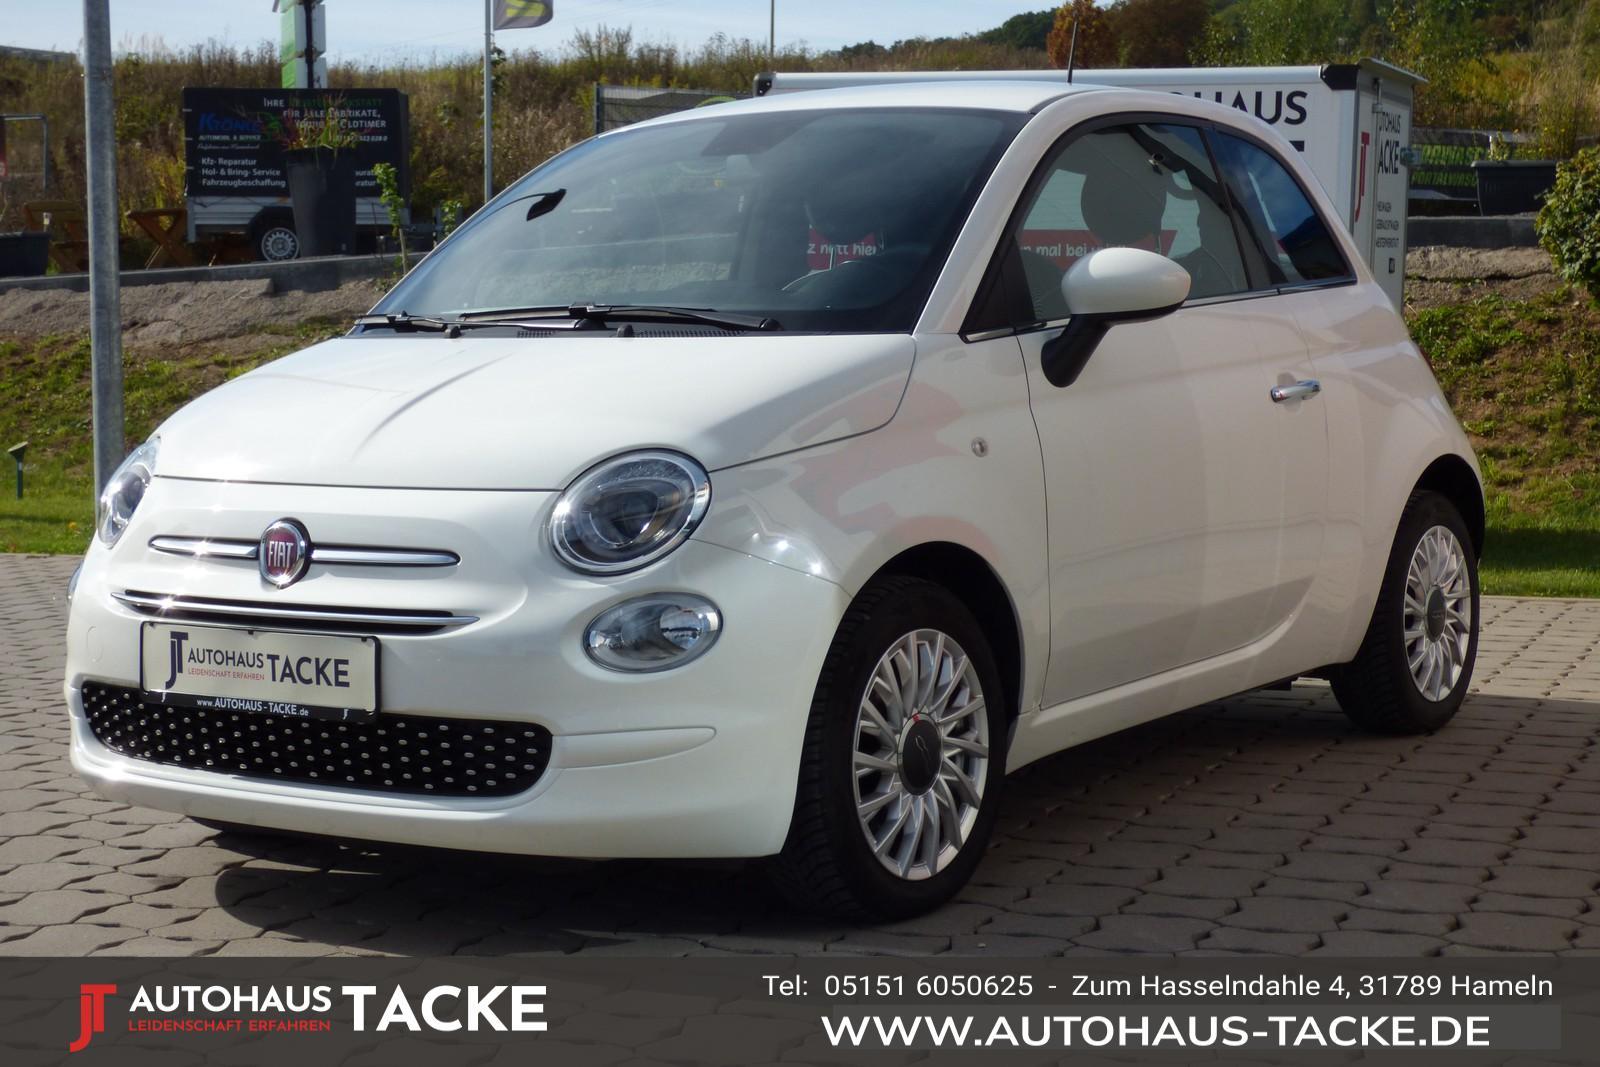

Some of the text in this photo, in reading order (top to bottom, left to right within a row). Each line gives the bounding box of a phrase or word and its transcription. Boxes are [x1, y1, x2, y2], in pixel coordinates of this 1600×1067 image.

[218, 158, 257, 168] Reparatur
[252, 168, 281, 177] Service
[202, 178, 287, 189] Fahrzeugbeschaffung
[1036, 243, 1061, 257] mal
[268, 540, 294, 568] FIAT
[188, 647, 264, 669] AUTOHAUS
[267, 654, 350, 688] TACKE
[188, 667, 265, 681] LEIDENSCHAFT ERFAHREN
